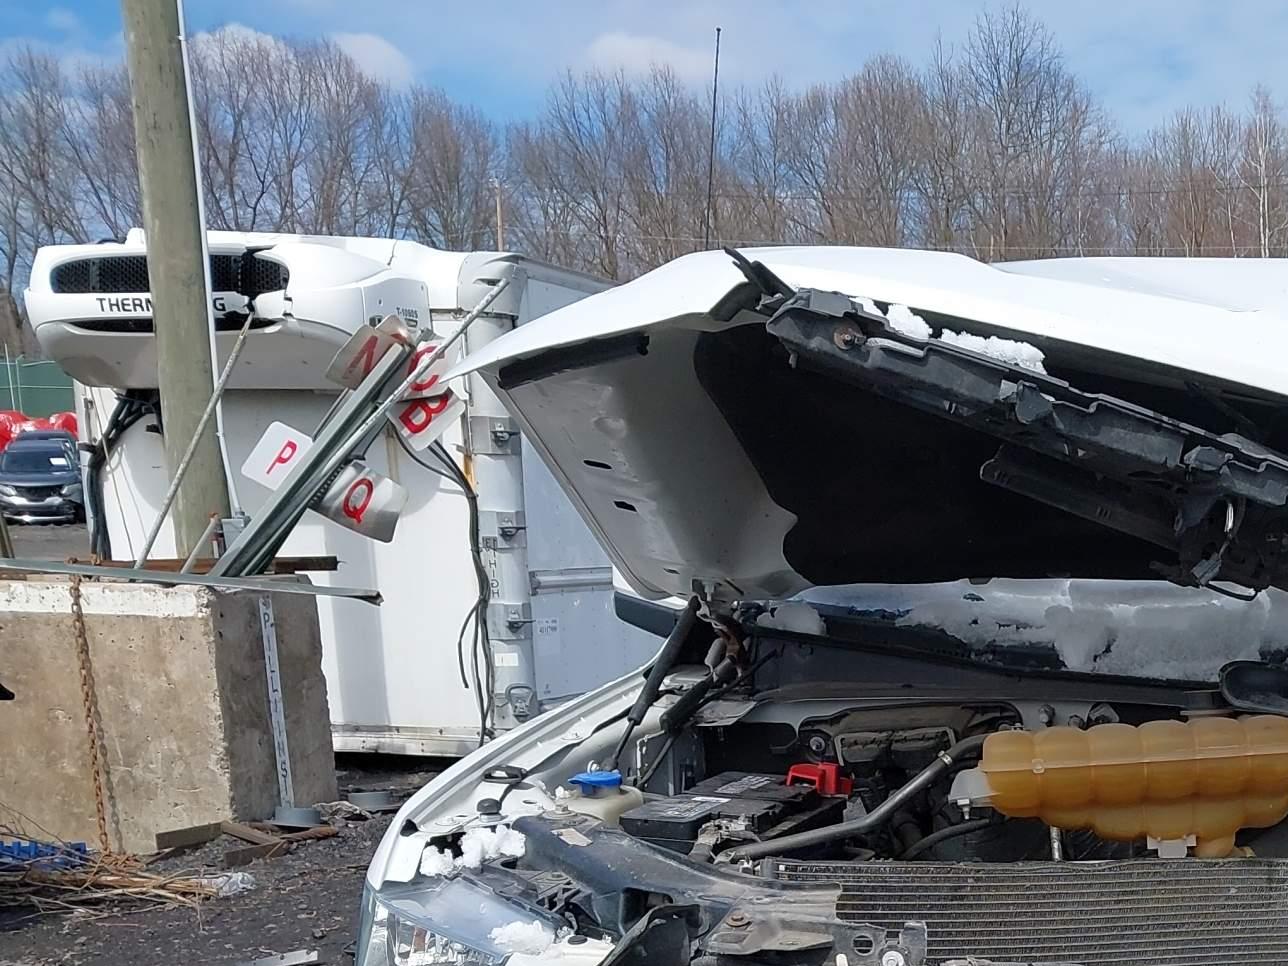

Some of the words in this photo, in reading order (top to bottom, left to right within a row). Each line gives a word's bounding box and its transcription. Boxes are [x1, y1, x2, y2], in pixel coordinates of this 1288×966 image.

[406, 344, 445, 392] C
[399, 393, 449, 434] B
[266, 439, 297, 475] P
[342, 477, 374, 525] Q
